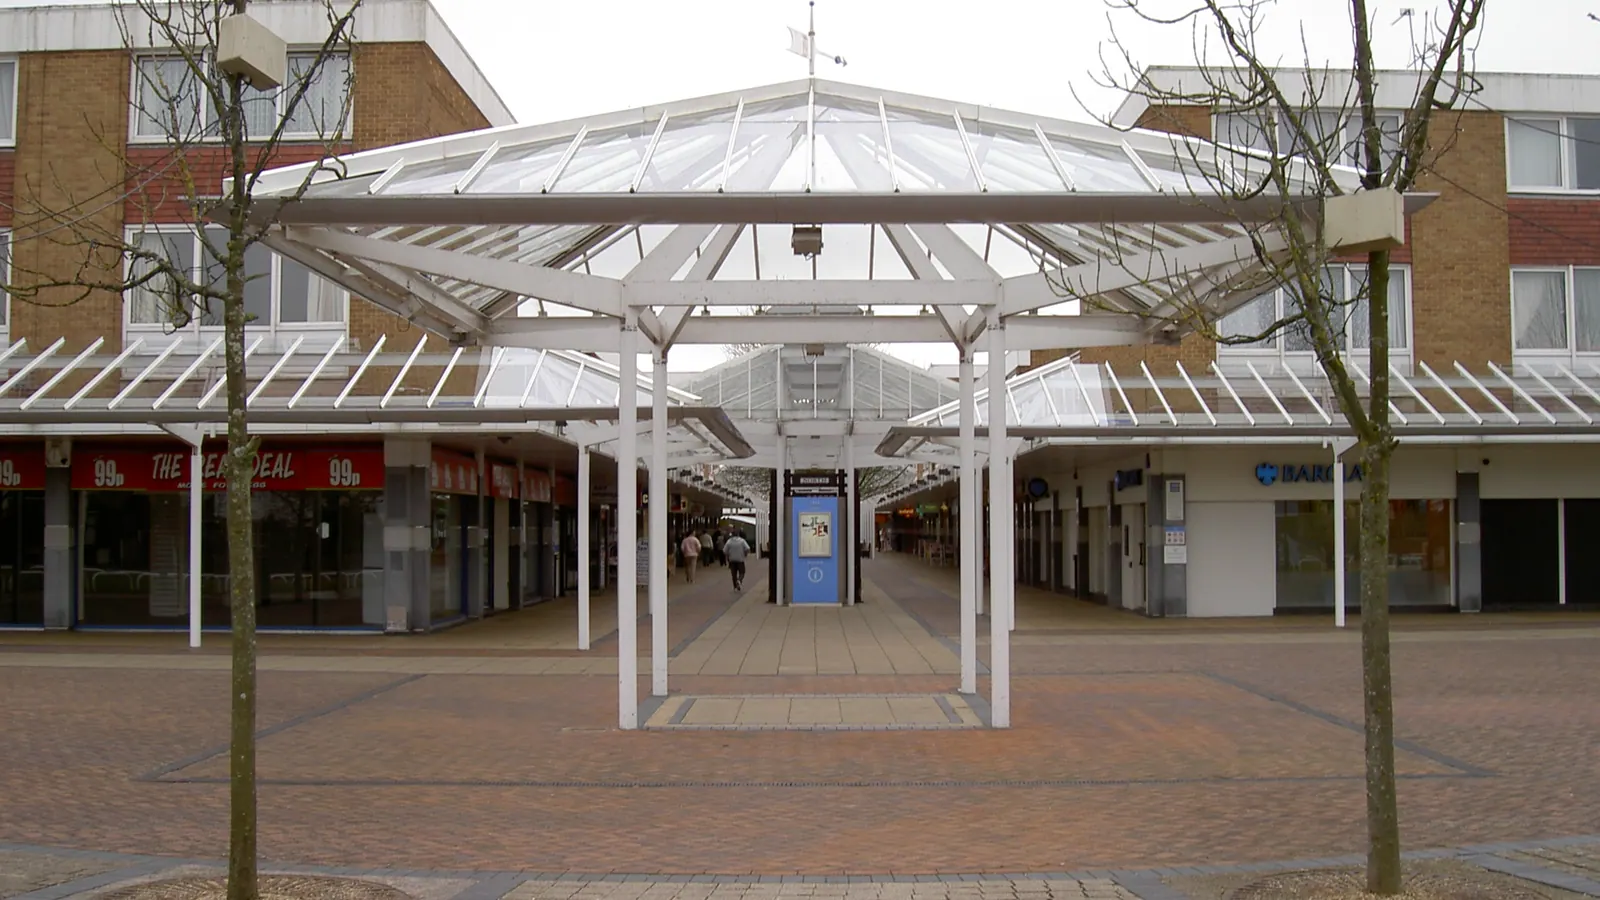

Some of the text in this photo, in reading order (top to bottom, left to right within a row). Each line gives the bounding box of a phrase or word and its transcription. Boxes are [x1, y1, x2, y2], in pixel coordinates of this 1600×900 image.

[94, 459, 125, 487] 99p
[152, 453, 184, 479] THE
[329, 458, 361, 487] 99p
